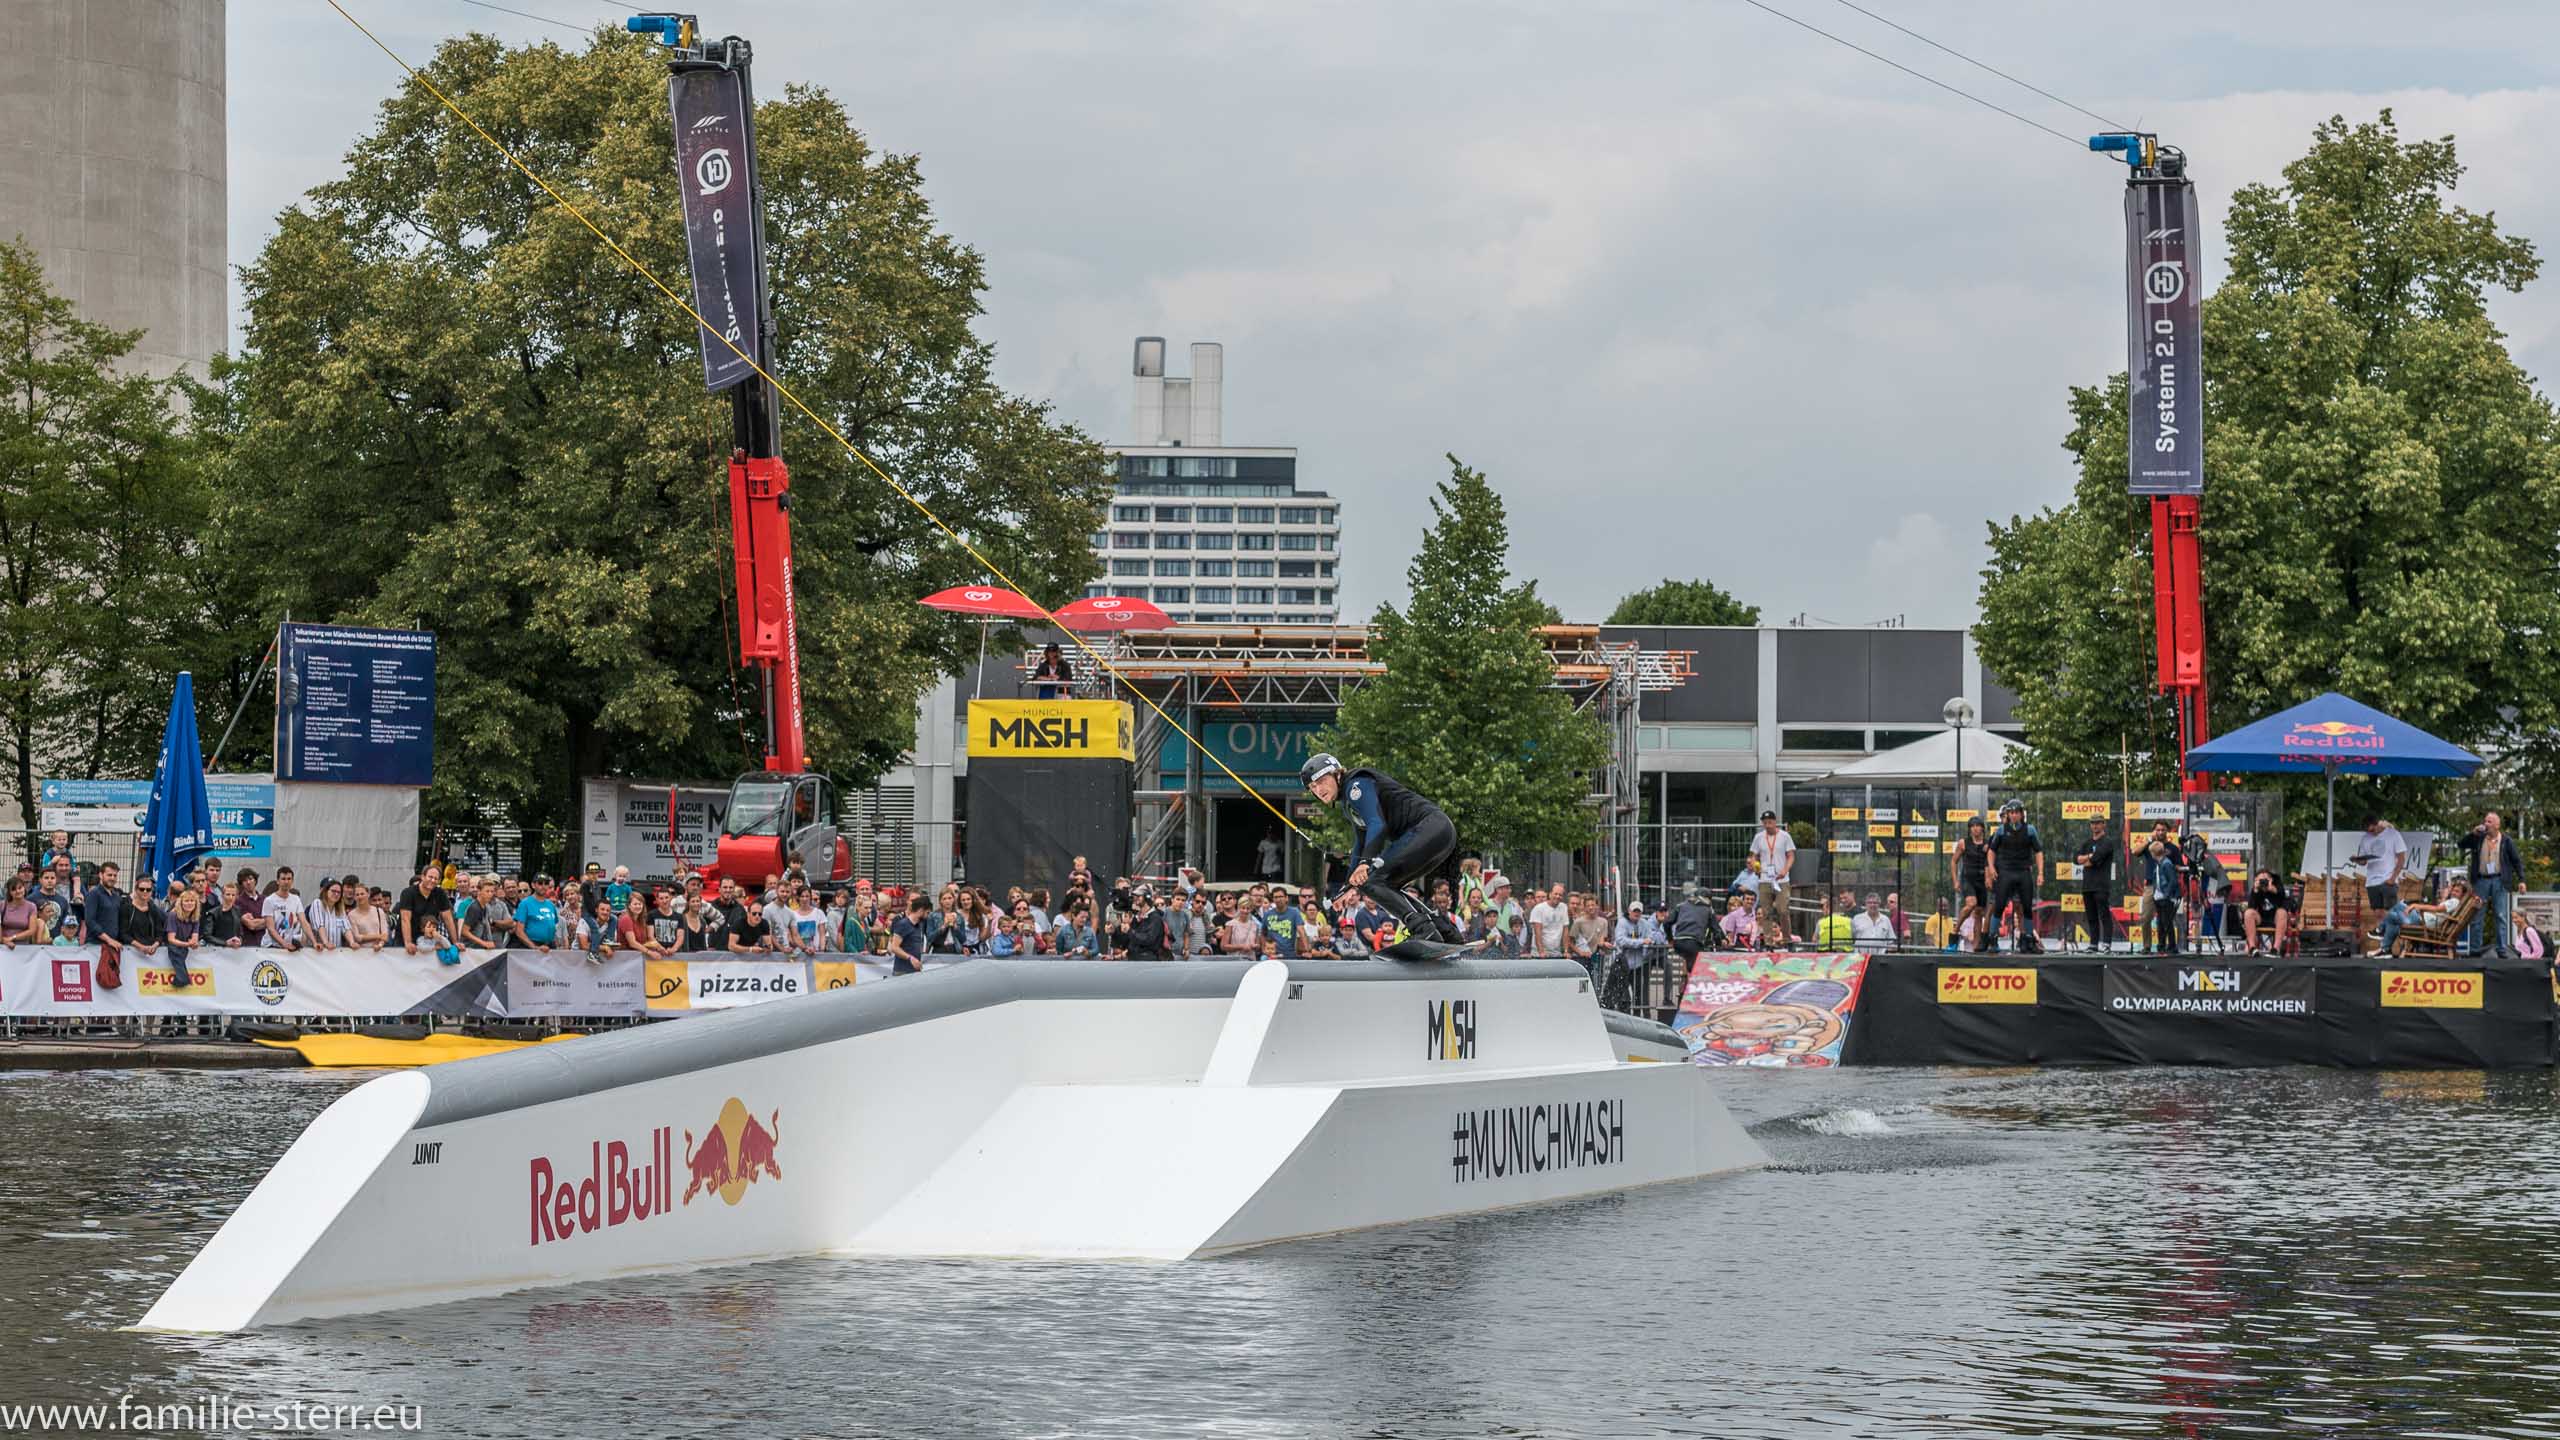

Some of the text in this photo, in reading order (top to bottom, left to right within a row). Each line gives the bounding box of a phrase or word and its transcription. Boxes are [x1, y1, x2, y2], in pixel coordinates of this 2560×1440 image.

[2155, 319, 2180, 453] System 2.0
[1023, 708, 1063, 716] MUNICH
[989, 718, 1088, 748] MASH
[2284, 734, 2385, 748] Red Bull
[630, 801, 664, 811] STREET
[2077, 803, 2104, 813] LOTTO
[2144, 806, 2180, 815] pizza.de
[2213, 836, 2249, 845] pizza.de
[687, 845, 703, 855] AIR
[700, 974, 797, 997] pizza.de
[1968, 975, 2026, 990] LOTTO
[2178, 970, 2240, 992] MASH
[2413, 979, 2472, 995] LOTTO
[2113, 997, 2306, 1013] OLYMPIAPARK MÜNCHEN
[1428, 1000, 1476, 1060] MASH
[1453, 1099, 1623, 1183] #MUNICHMASH
[530, 1126, 671, 1246] Red Bull
